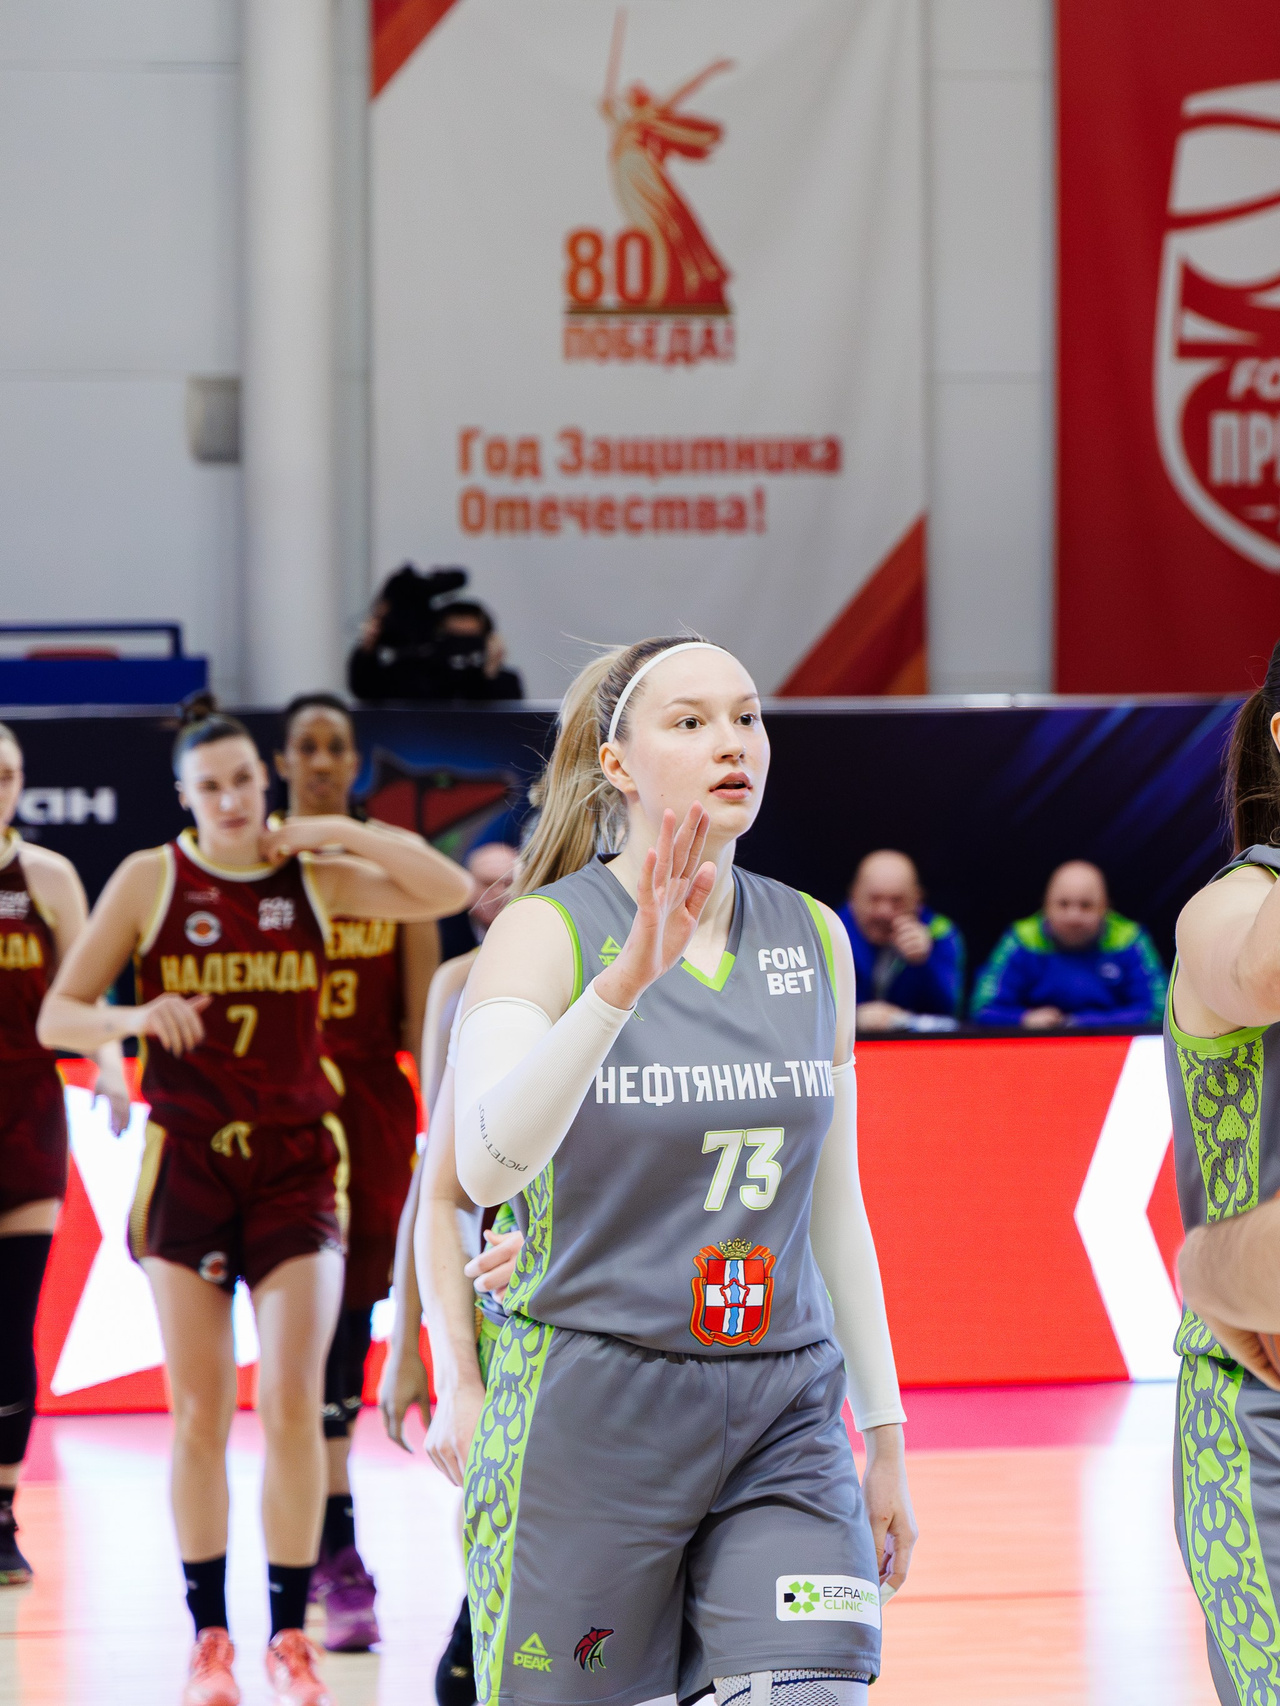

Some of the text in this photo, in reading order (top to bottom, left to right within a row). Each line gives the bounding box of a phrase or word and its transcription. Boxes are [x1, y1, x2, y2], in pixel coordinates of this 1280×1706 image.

[565, 228, 654, 306] 80
[563, 322, 737, 370] ПОБЕДА!
[458, 426, 843, 482] Год Защитника
[459, 485, 768, 536] Отечества!
[160, 950, 318, 994] НАДЕЖДА
[758, 945, 808, 972] FON
[766, 968, 815, 996] BET
[226, 1004, 258, 1058] 7
[701, 1127, 785, 1212] 73
[823, 1599, 864, 1613] CLINIC
[513, 1652, 552, 1673] PEAK
